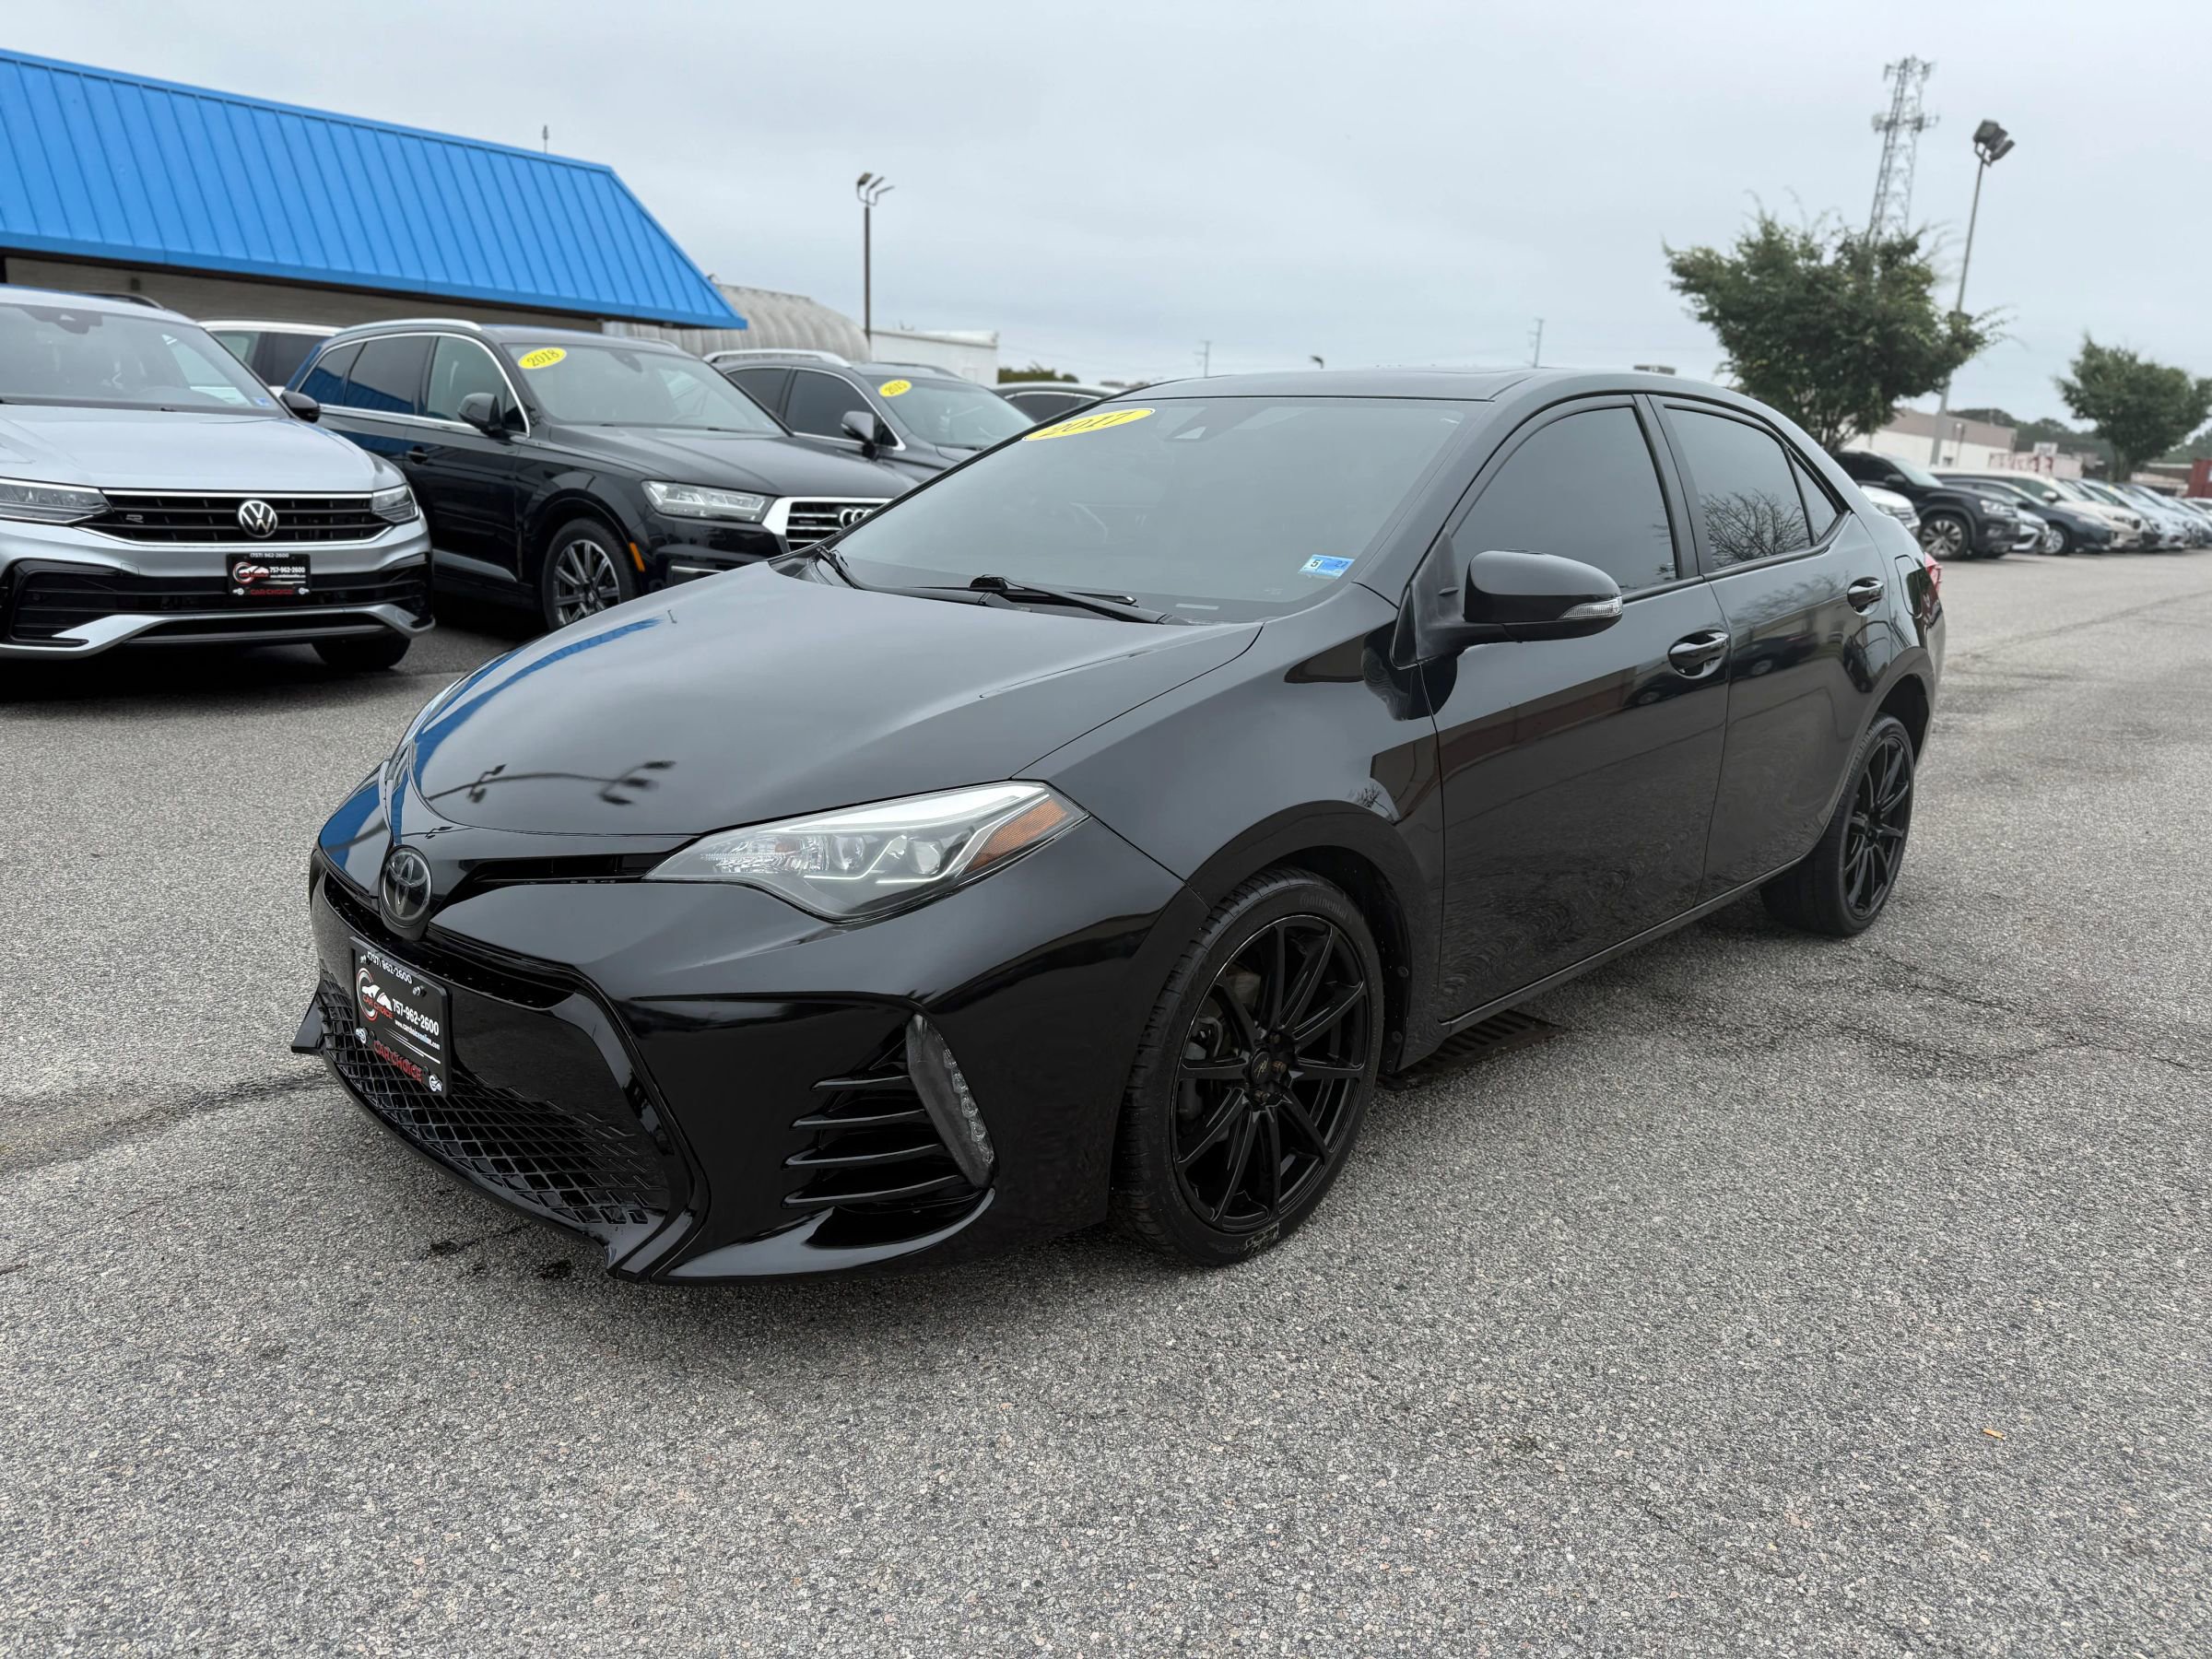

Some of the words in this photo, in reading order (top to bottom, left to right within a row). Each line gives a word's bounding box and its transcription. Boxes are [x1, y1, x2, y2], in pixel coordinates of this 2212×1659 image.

[526, 348, 559, 367] 2018
[1039, 410, 1136, 438] 2017
[382, 959, 413, 984] 962-2600
[362, 994, 374, 1008] CAR
[374, 1001, 394, 1019] CHOICE
[392, 998, 440, 1037] 757-962-2600
[373, 1040, 391, 1062] CAR
[390, 1051, 423, 1083] CHOICE
